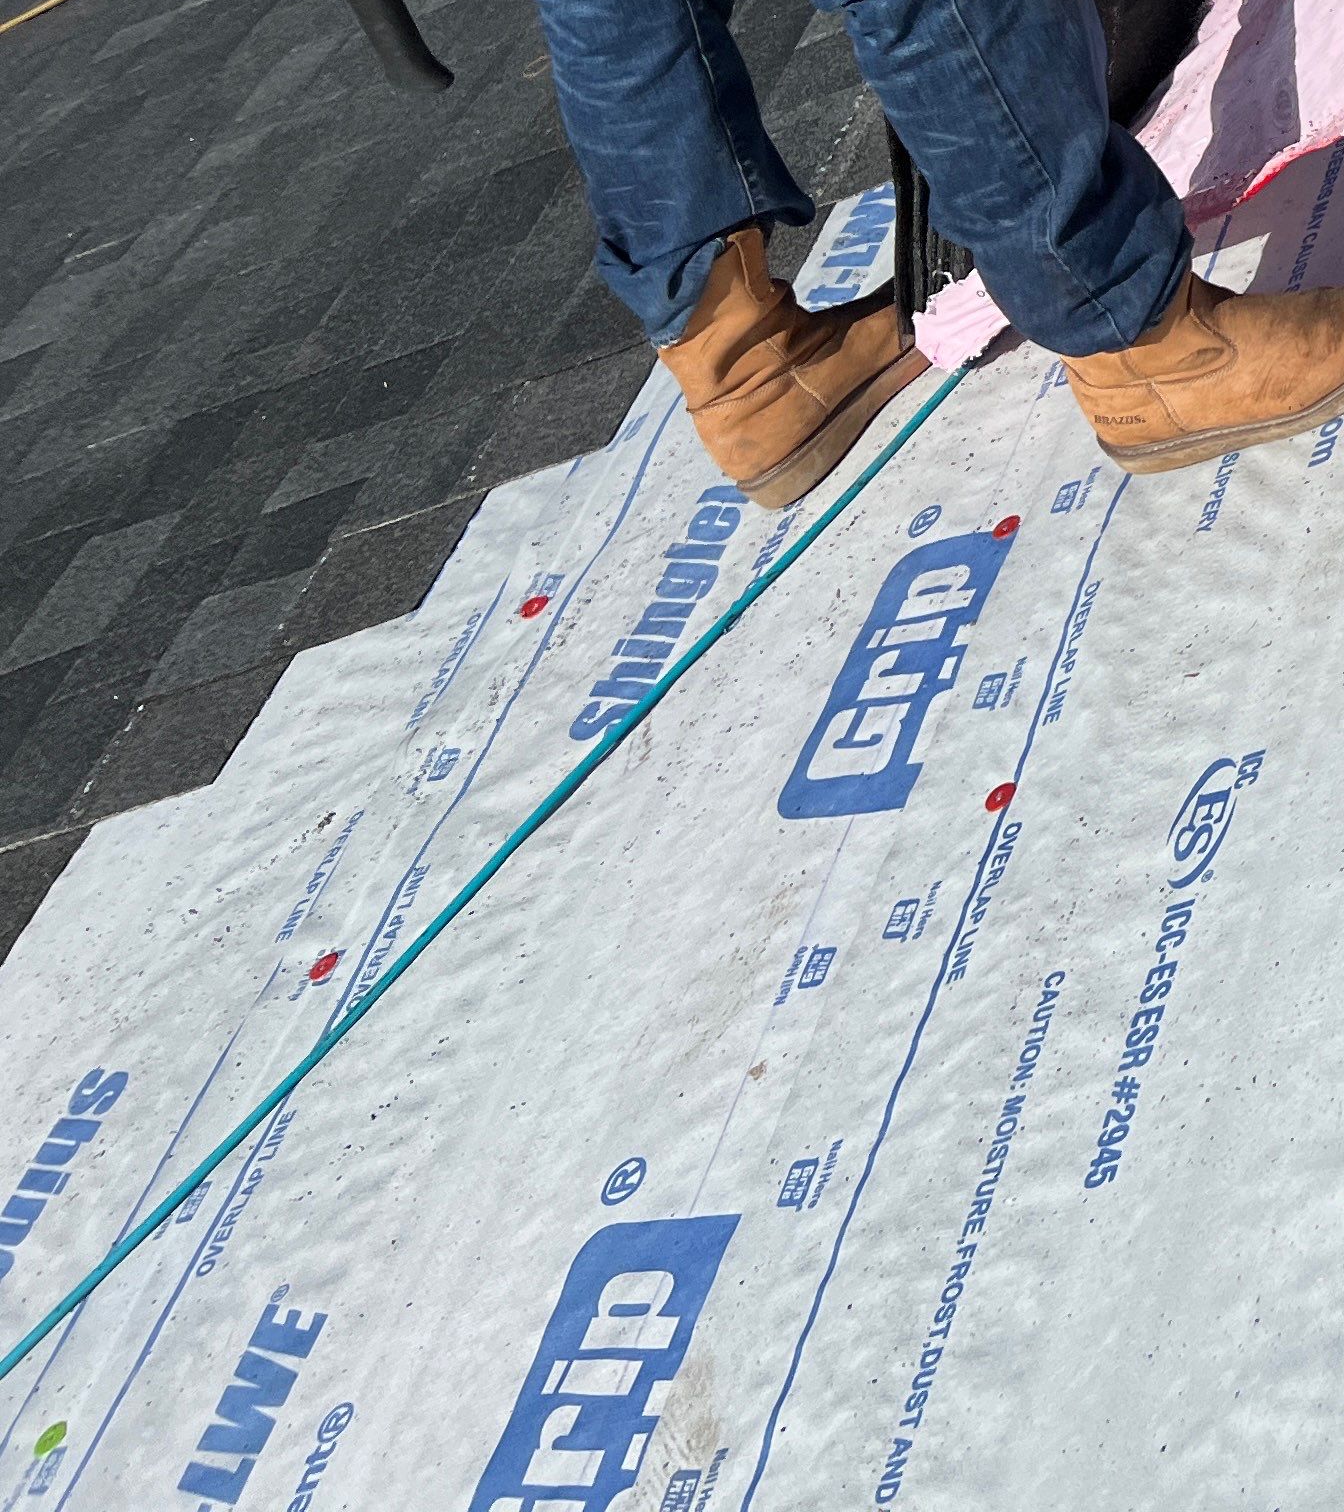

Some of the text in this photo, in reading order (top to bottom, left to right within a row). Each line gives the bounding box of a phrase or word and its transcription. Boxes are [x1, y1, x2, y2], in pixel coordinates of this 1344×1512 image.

[1194, 451, 1241, 534] SLIPPERY
[805, 563, 977, 782] Grip
[1042, 581, 1101, 727] OVERLAP LINE
[1174, 788, 1231, 860] ES
[1232, 749, 1266, 791] ICC
[274, 809, 365, 944] OVERLAP LINE
[911, 879, 944, 941] Nail Here
[945, 821, 1023, 985] OVERLAP LINE
[346, 864, 432, 1013] OVERLAP LINE
[773, 945, 809, 1007] Nail Here
[1010, 969, 1066, 1092] CAUTION:
[1082, 898, 1195, 1191] ICC-ES ESR #2945
[195, 1108, 299, 1278] OVERLAP LINE
[807, 1138, 844, 1210] Nail Here
[488, 1269, 682, 1512] rip
[704, 1447, 730, 1485] Nail
[874, 1436, 914, 1506] AND
